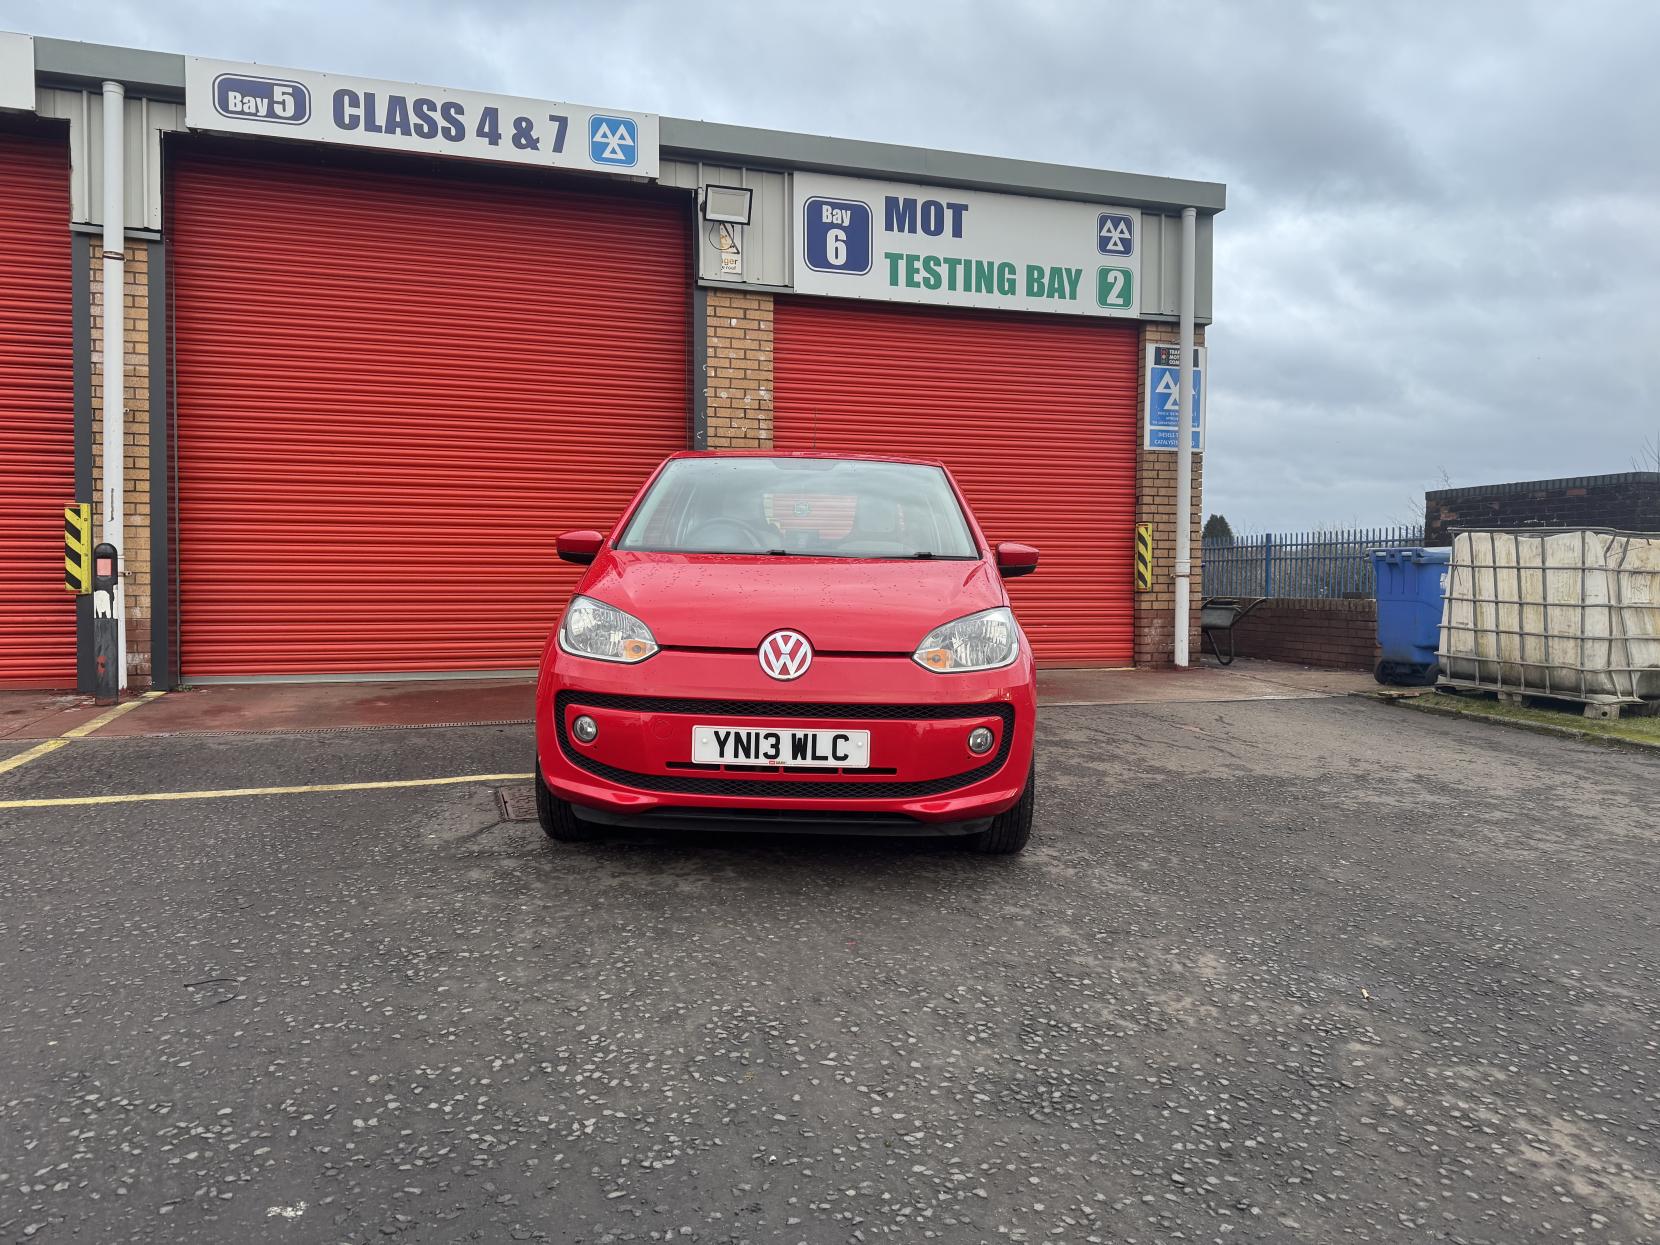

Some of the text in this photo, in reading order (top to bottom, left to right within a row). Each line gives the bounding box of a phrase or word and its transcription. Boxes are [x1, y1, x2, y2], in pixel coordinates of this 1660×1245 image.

[228, 85, 296, 118] Bay 5
[332, 88, 569, 153] CLASS 4 & 7
[822, 204, 851, 227] Bay
[884, 195, 969, 239] MOT
[826, 228, 847, 266] 6
[884, 251, 1083, 301] TESTING BAY
[1106, 270, 1125, 305] 2
[713, 730, 850, 762] YN13 WLC
